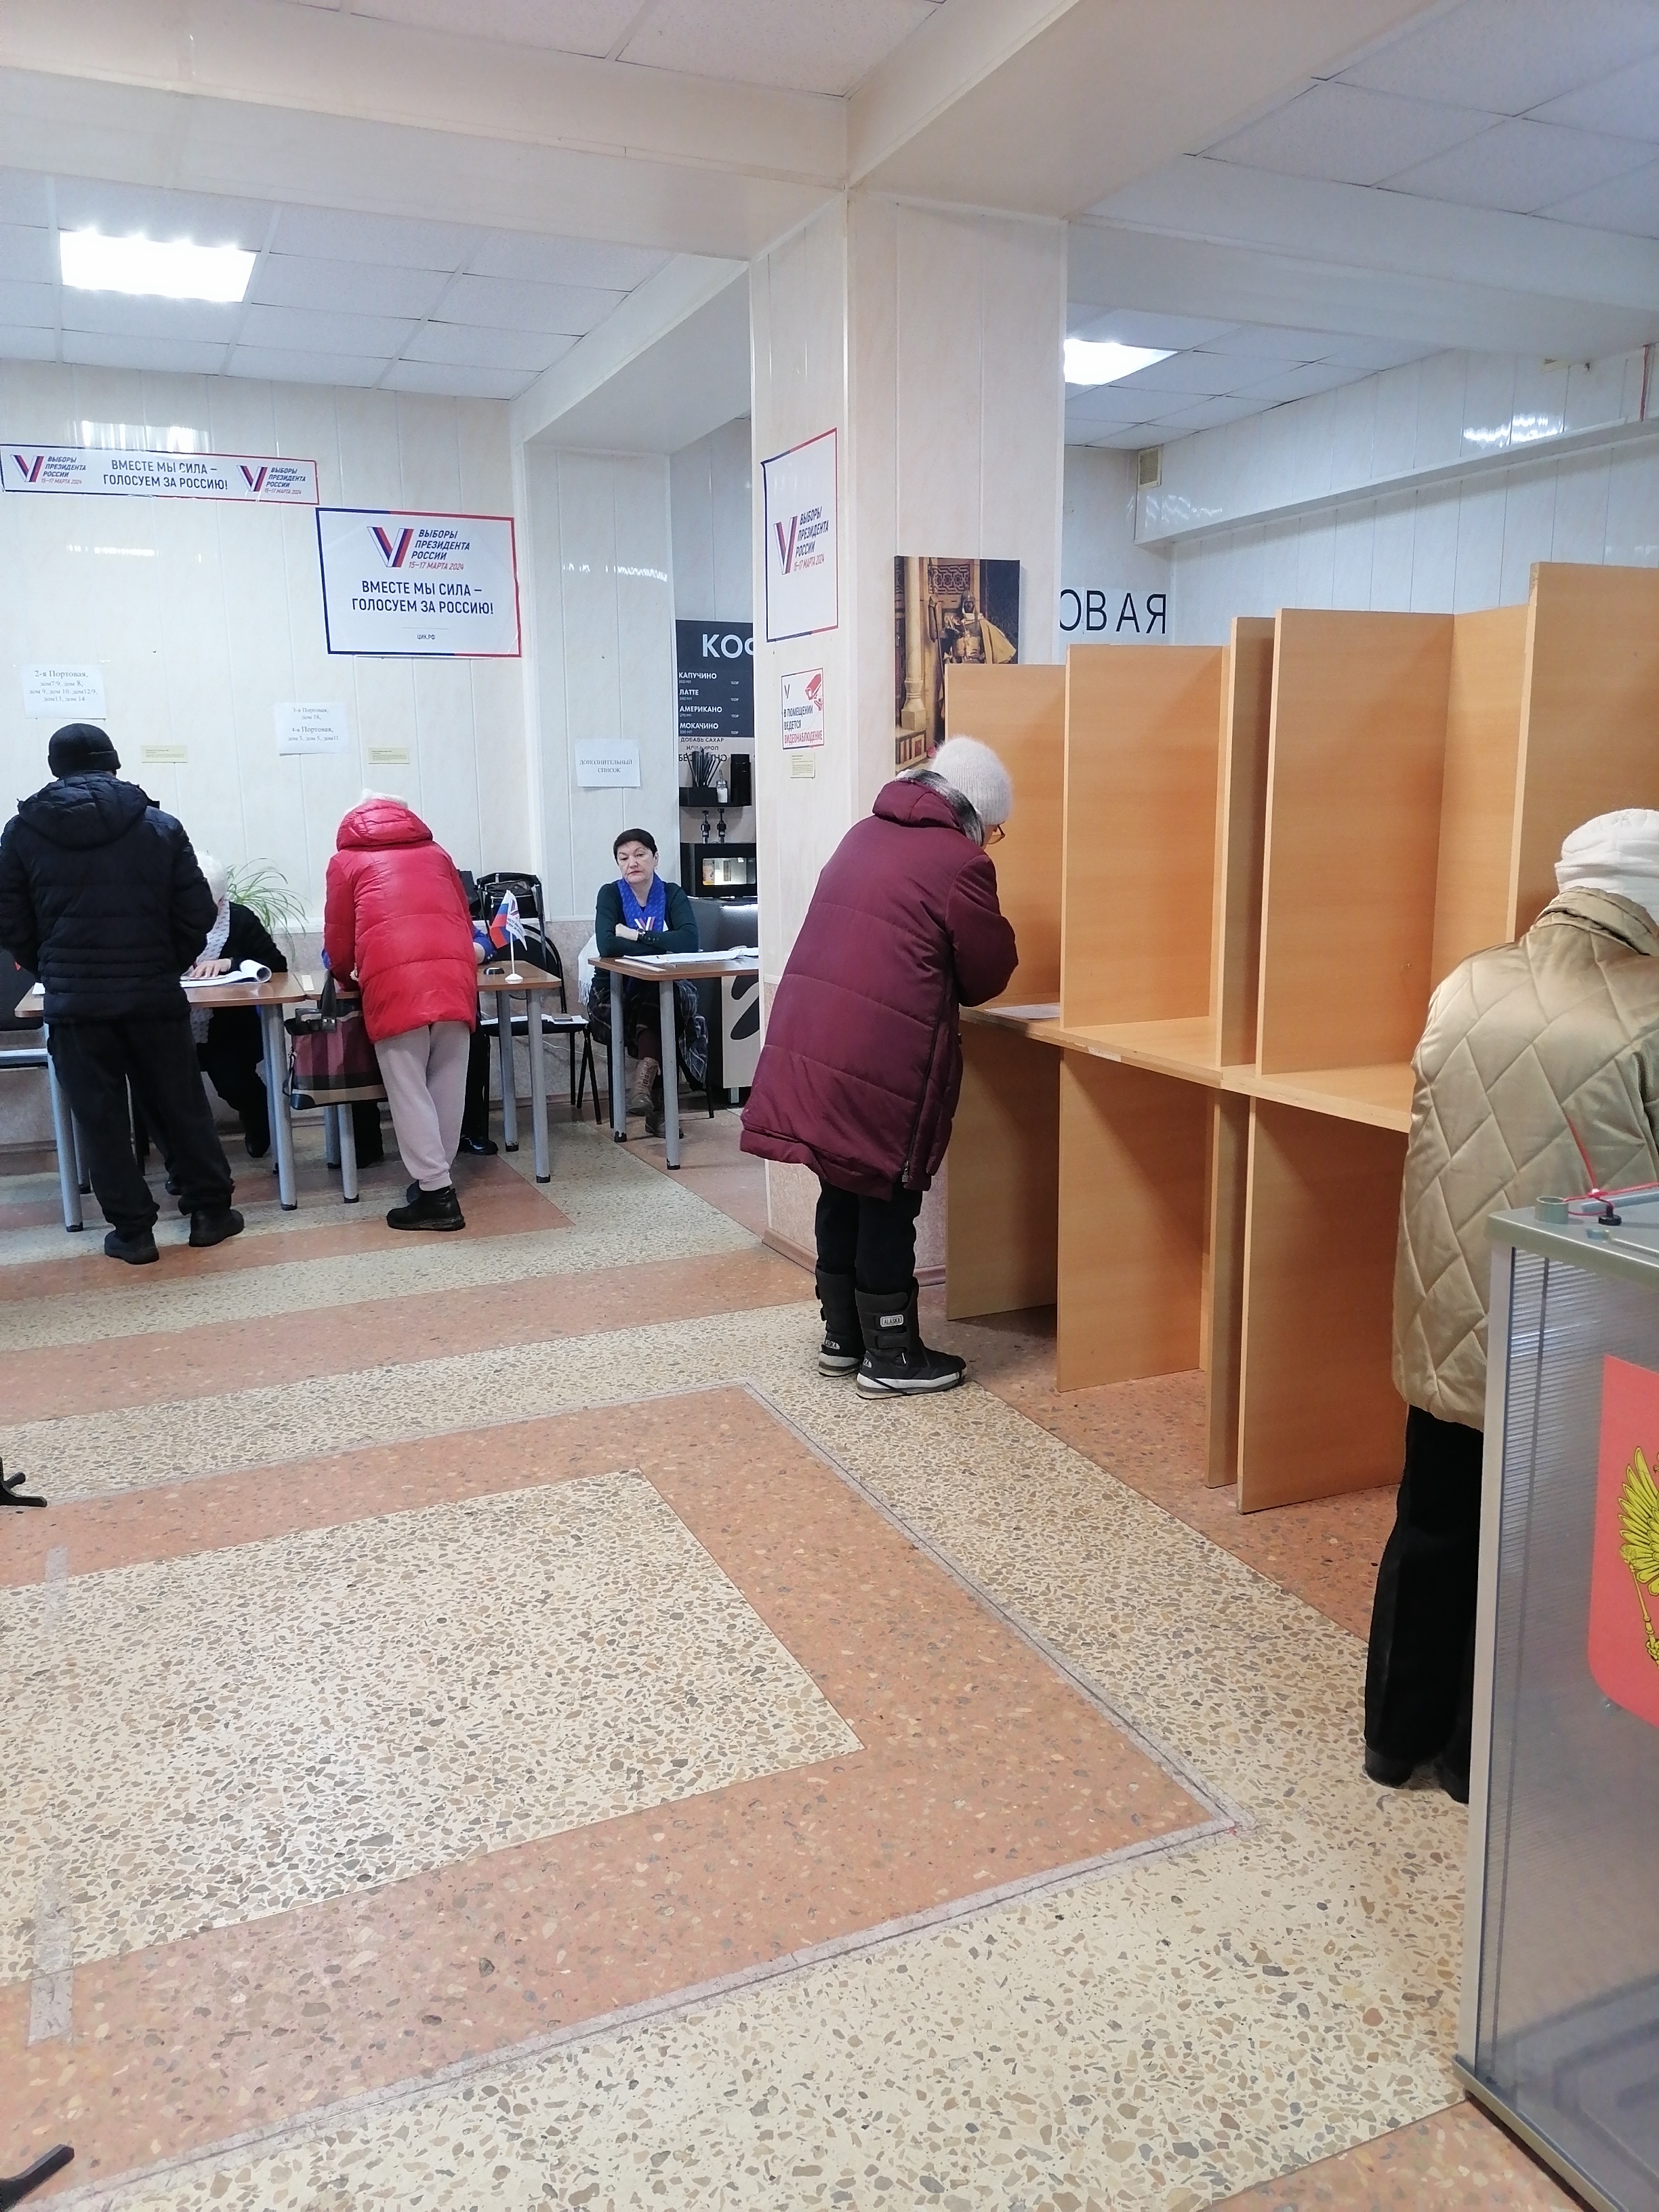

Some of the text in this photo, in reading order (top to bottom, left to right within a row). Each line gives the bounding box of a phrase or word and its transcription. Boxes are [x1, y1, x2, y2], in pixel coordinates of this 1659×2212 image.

[111, 459, 154, 472] ВМЕСТЕ
[157, 462, 176, 473] МЫ
[179, 462, 207, 474] СИЛА
[103, 474, 228, 490] ГОЛОСУЕМ ЗА РОССИЮ!
[800, 506, 822, 525] ВЫБОРЫ
[418, 529, 458, 539] ВЫБОРЫ
[798, 520, 828, 541] ПРЕЗИДЕНТА
[414, 540, 470, 551] ПРЕЗИДЕНТА
[796, 541, 815, 558] РОССИИ
[411, 551, 447, 560] РОССИИ
[362, 580, 410, 594] ВМЕСТЕ
[414, 582, 435, 595] МЫ
[439, 583, 471, 596] СИЛА
[352, 598, 494, 615] ГОЛОСУЕМ ЗА РОССИЮ!
[1060, 589, 1166, 634] ОВАЯ
[49, 670, 88, 679] Портовая,
[784, 705, 813, 717] В ПОМЕЩЕНИИ
[784, 720, 801, 731] ВЕДЕТСЯ
[785, 731, 822, 745] ВИДЕОНАБЛЮДЕНИЕ
